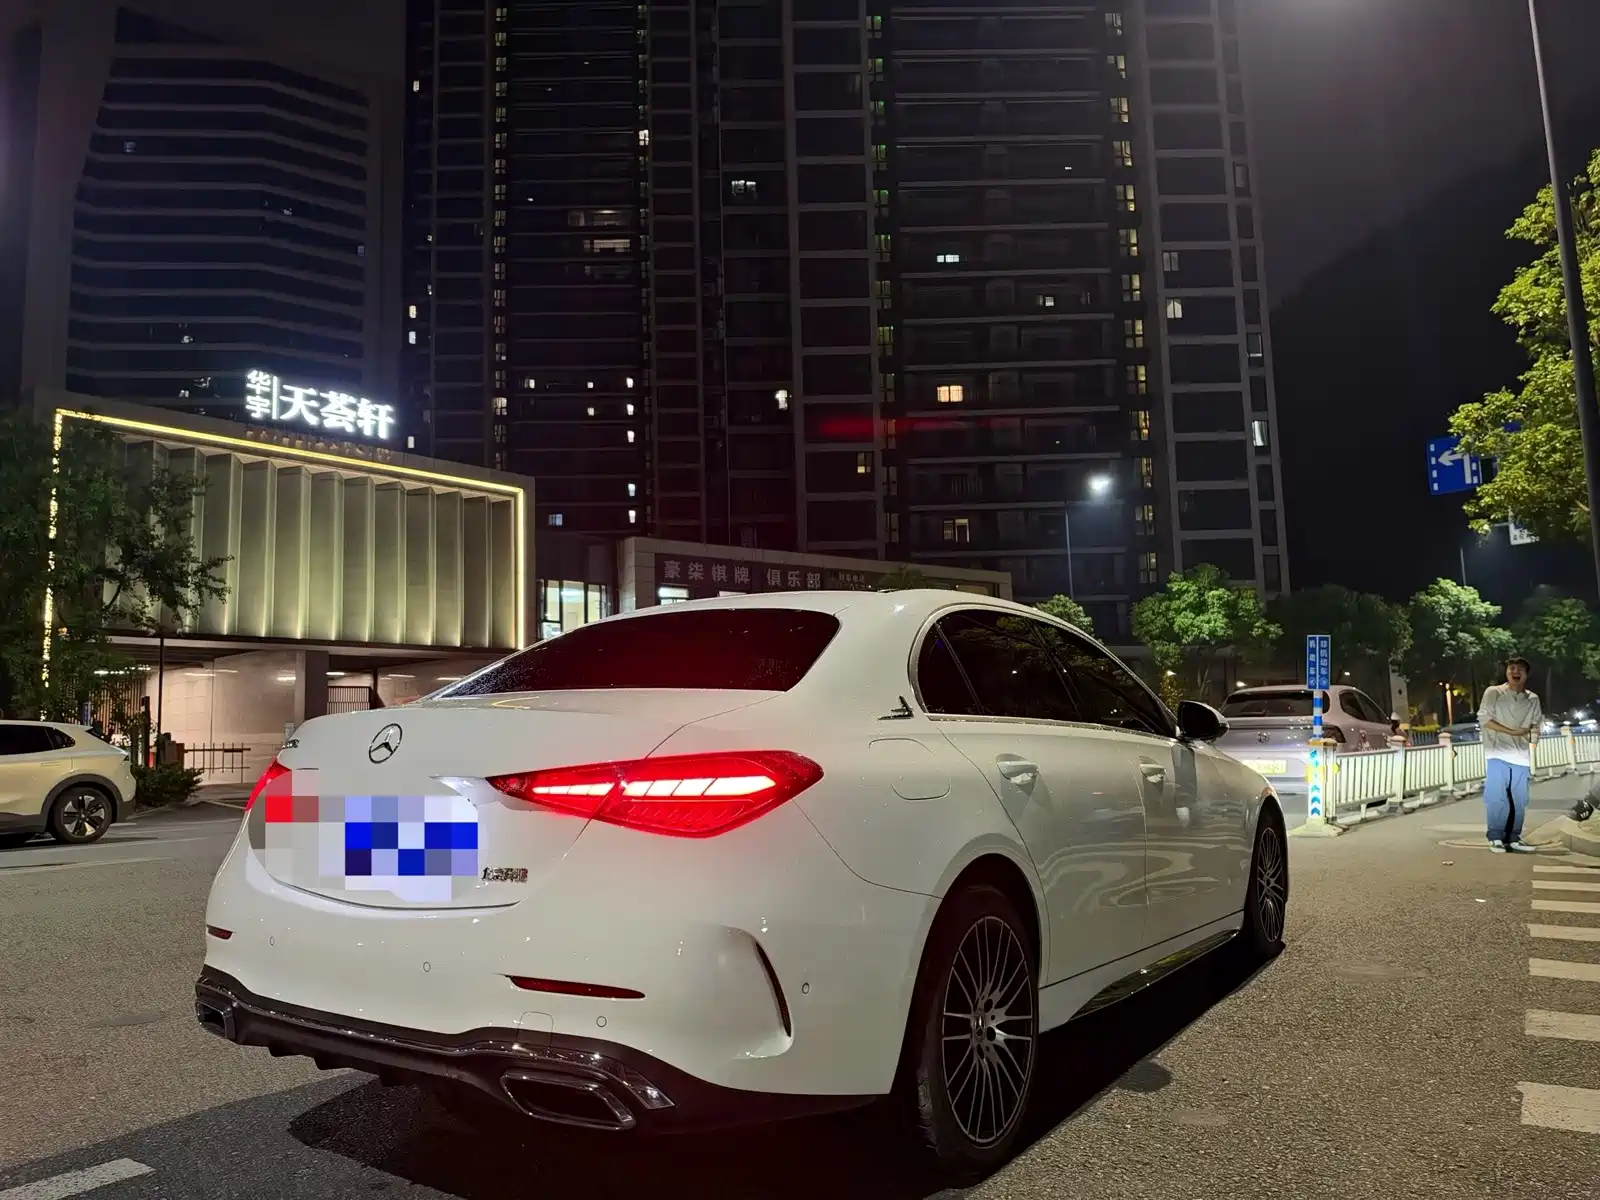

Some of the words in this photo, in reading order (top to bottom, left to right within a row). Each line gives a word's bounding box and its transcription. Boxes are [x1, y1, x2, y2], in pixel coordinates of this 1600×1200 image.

[279, 384, 396, 440] 天荟轩
[663, 560, 750, 584] 豪柒棋牌
[766, 568, 821, 589] 俱乐部
